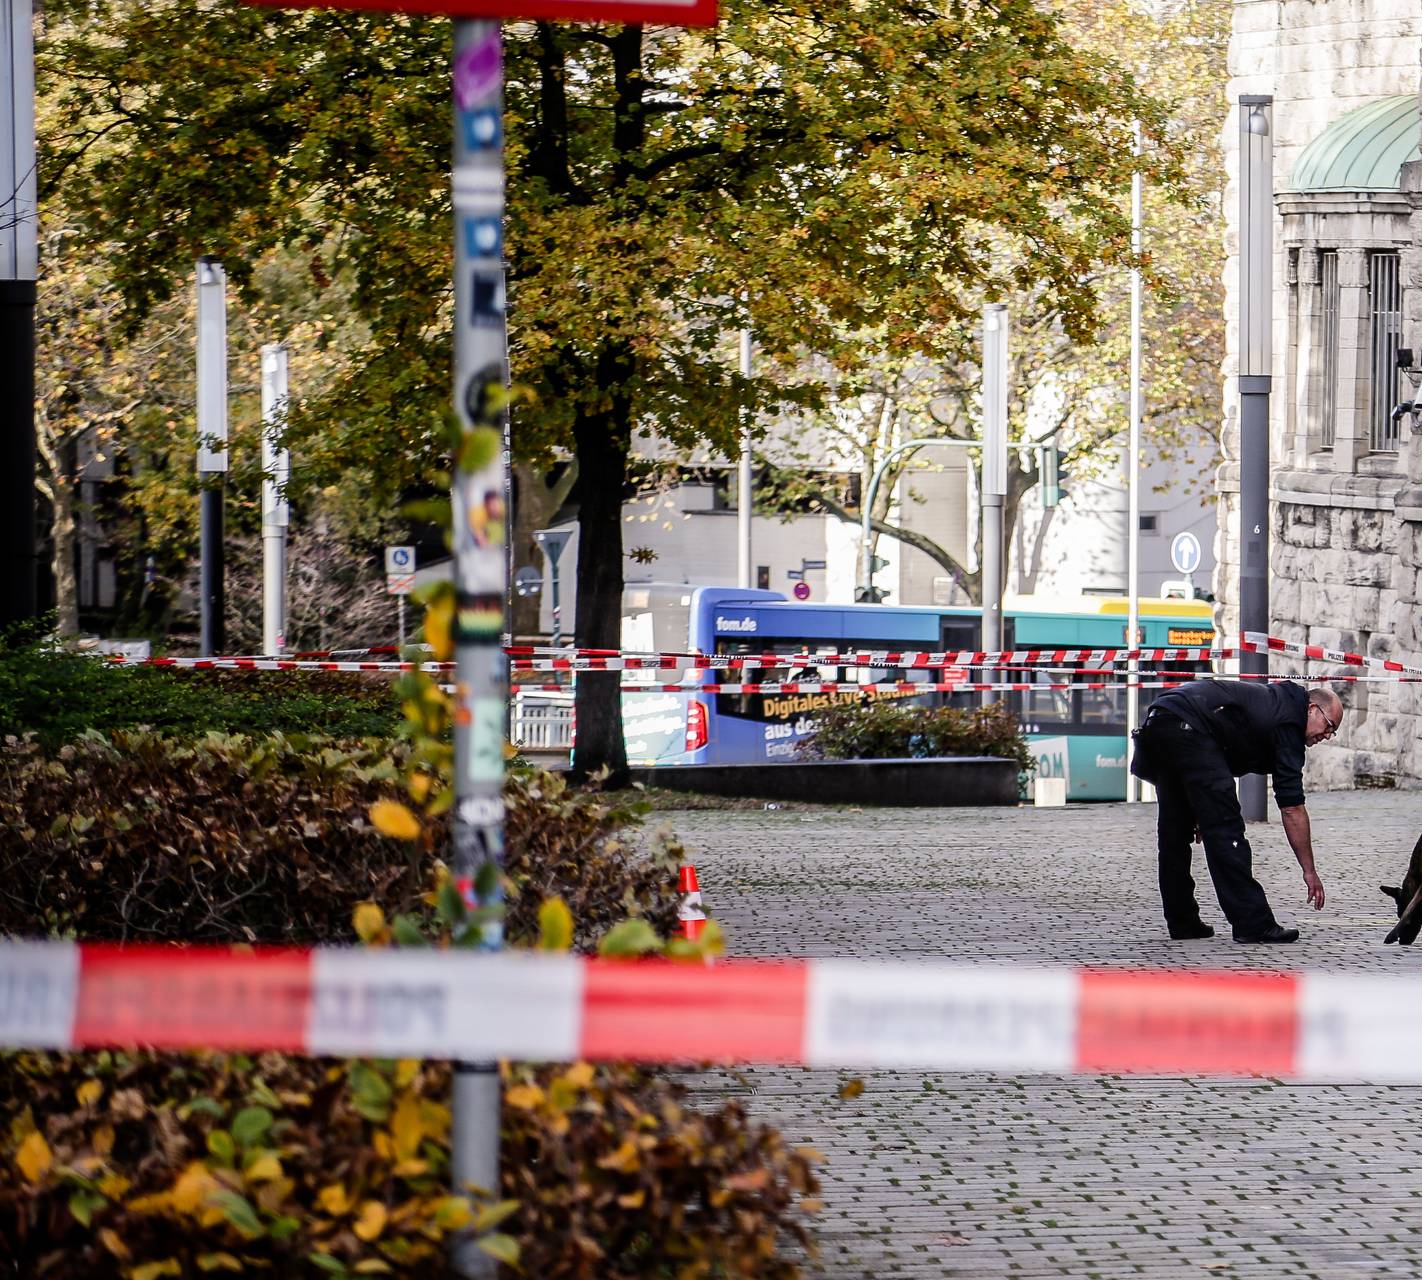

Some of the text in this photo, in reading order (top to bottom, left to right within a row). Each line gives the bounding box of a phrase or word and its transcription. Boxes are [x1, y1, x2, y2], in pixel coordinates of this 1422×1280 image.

[1253, 524, 1261, 534] 6
[716, 616, 757, 632] fom.de
[763, 693, 828, 719] Digitales
[764, 722, 793, 741] aus
[1096, 754, 1127, 768] fom.d
